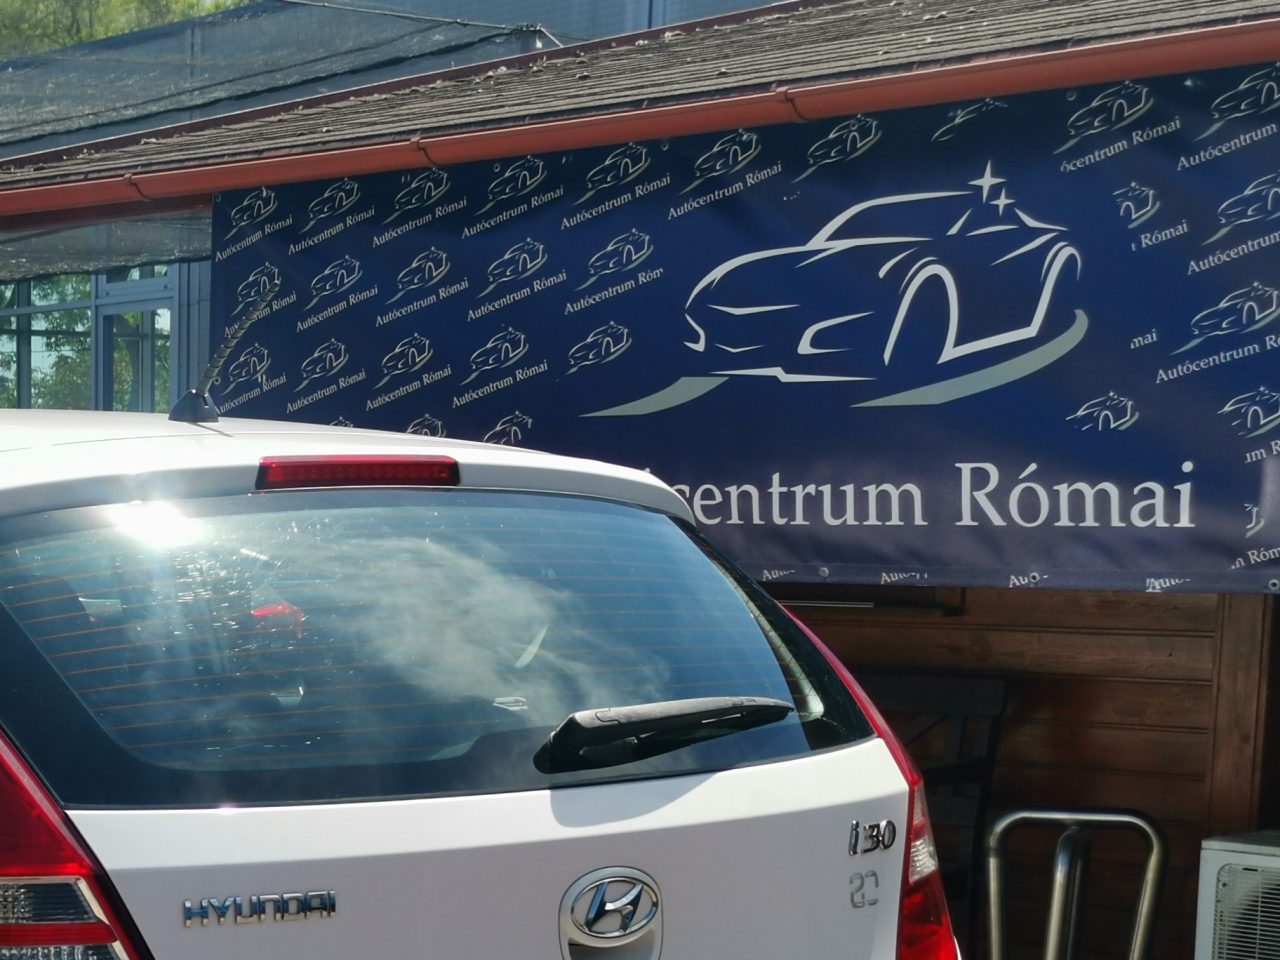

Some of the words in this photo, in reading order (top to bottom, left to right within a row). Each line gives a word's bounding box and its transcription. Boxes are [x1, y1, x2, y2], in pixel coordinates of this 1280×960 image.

[1132, 115, 1182, 145] Római
[1176, 122, 1277, 171] Autócentrum
[461, 203, 528, 239] Autócentrum
[530, 184, 564, 208] Római
[561, 195, 633, 231] Autócentrum
[634, 175, 671, 199] Római
[667, 184, 744, 220] Autócentrum
[745, 163, 783, 188] Római
[215, 229, 263, 263] Autócentrum
[264, 214, 293, 234] Római
[287, 222, 345, 255] Autócentrum
[345, 205, 376, 227] Római
[372, 214, 433, 248] Autócentrum
[434, 196, 468, 218] Római
[1140, 219, 1189, 248] Római
[296, 300, 348, 333] Autócentrum
[348, 285, 379, 306] Római
[375, 294, 437, 328] Autócentrum
[438, 276, 469, 300] Római
[467, 289, 531, 322] Autócentrum
[532, 269, 567, 292] Római
[564, 279, 637, 316] Autócentrum
[365, 377, 421, 412] Autócentrum
[422, 363, 452, 385] Római
[452, 375, 513, 409] Autócentrum
[515, 359, 549, 380] Római
[1156, 343, 1260, 384] Autócentrum
[286, 384, 338, 415] Autócentrum
[338, 368, 367, 388] Római
[955, 461, 1196, 527] Római
[184, 889, 337, 929] HYUNDAI
